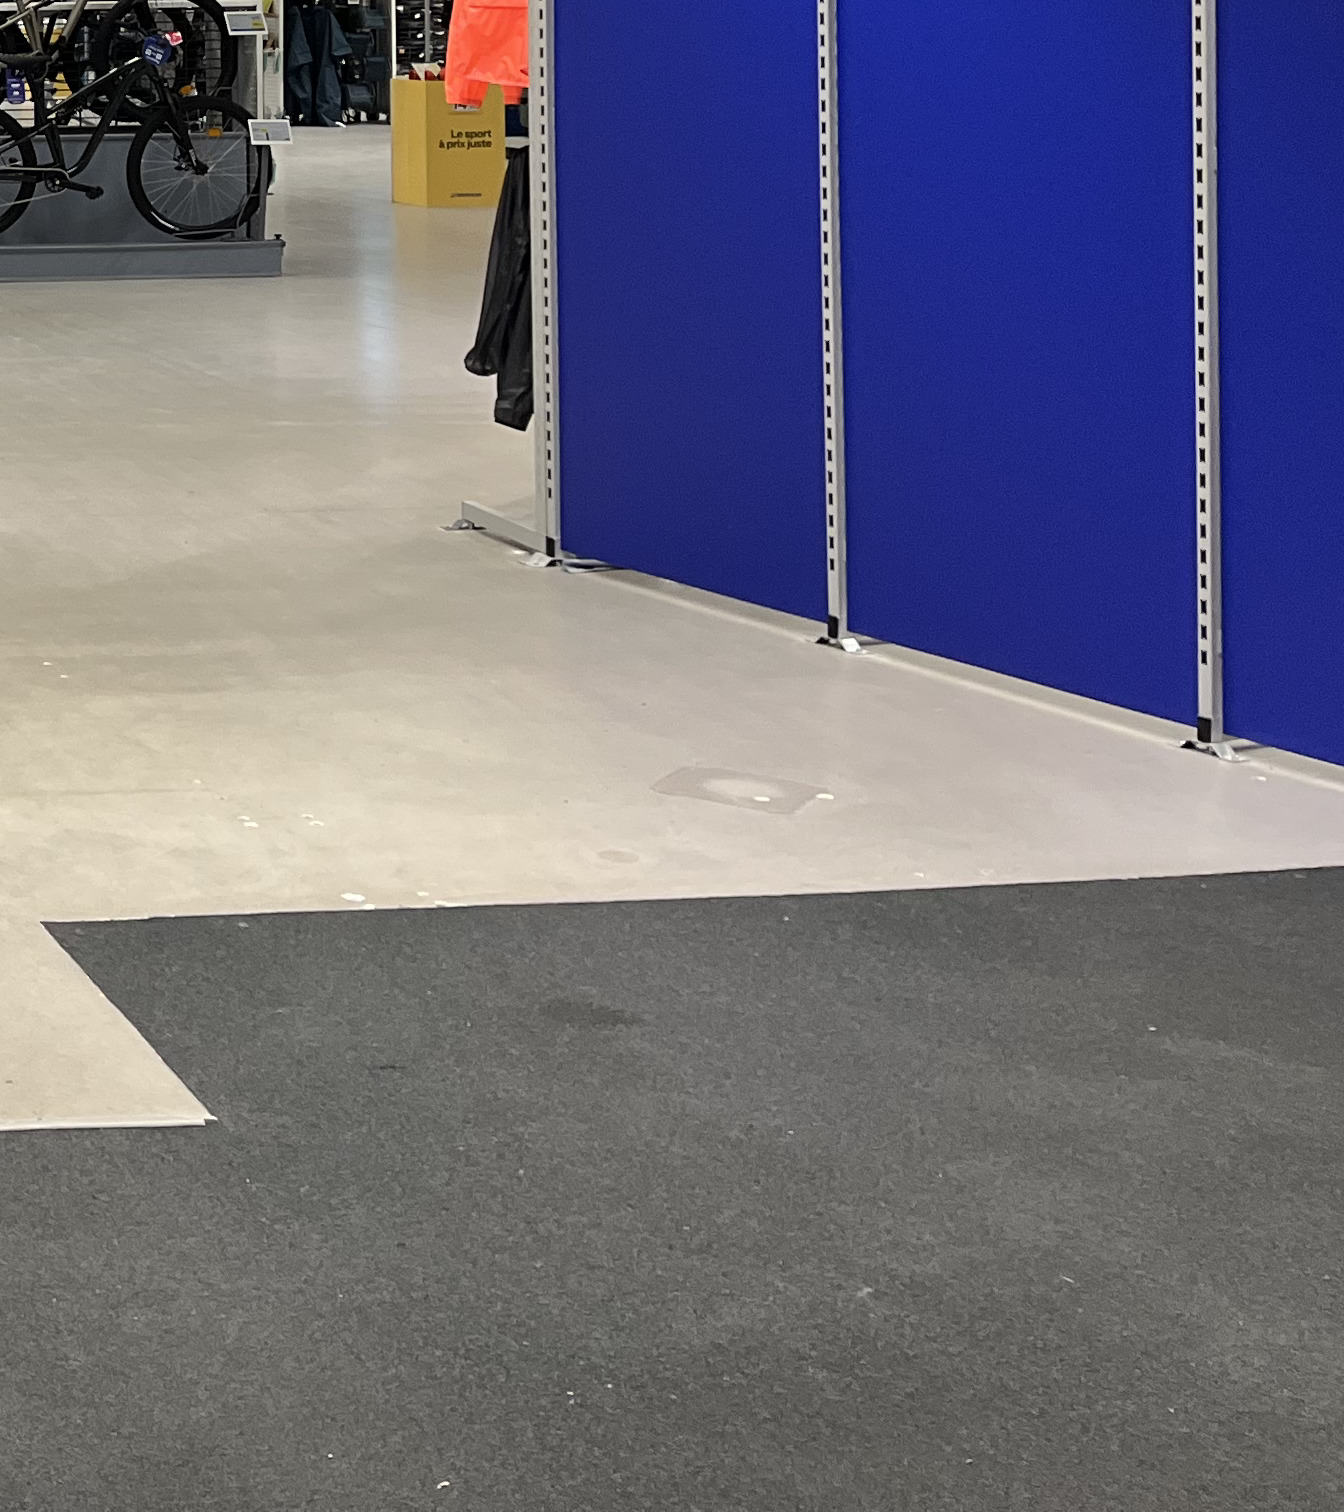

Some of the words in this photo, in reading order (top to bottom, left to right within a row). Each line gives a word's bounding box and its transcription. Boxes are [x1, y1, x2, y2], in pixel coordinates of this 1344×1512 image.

[450, 129, 464, 139] Le
[464, 129, 492, 140] sport
[438, 139, 446, 148] à
[446, 139, 465, 150] prix
[466, 139, 492, 150] juste
